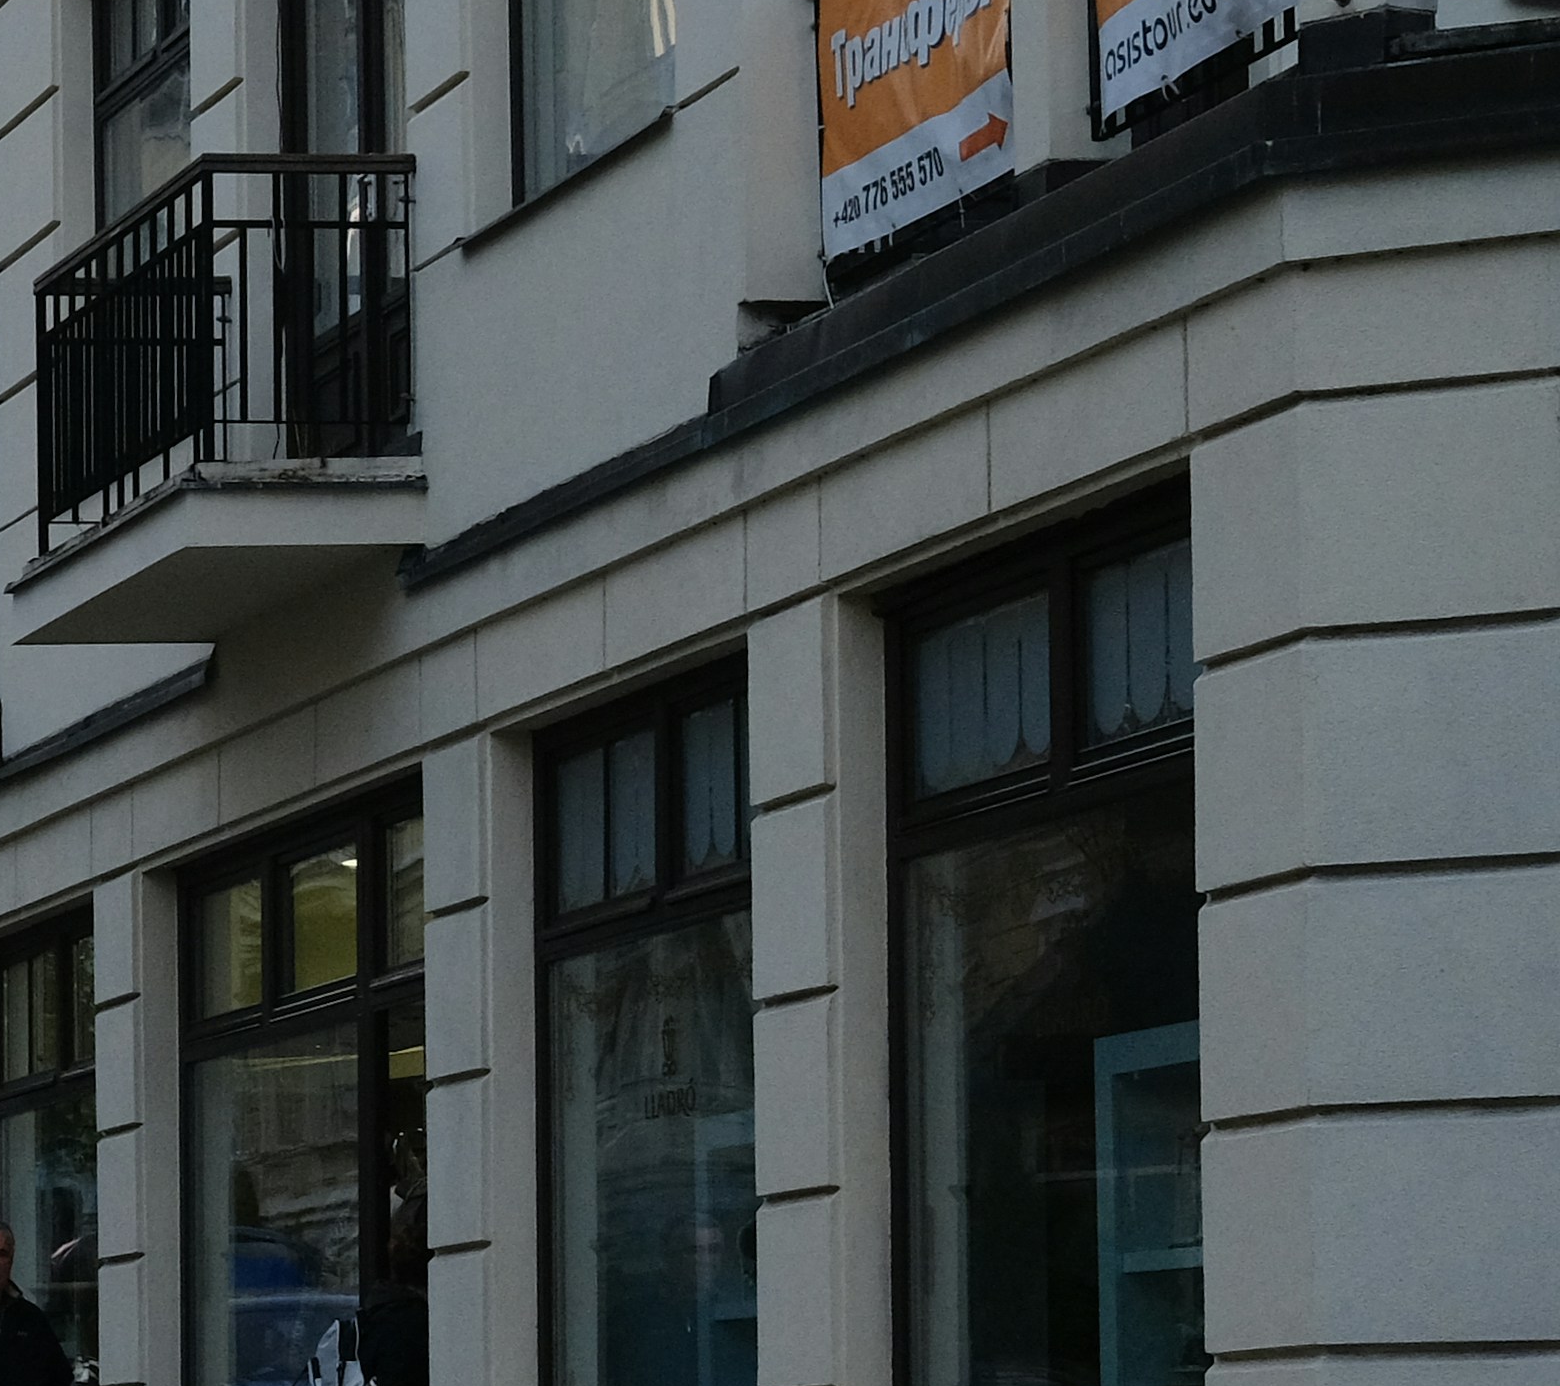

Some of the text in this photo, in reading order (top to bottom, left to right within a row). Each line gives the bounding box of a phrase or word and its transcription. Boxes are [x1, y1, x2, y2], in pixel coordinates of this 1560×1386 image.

[832, 147, 945, 229] +420 776 555 570
